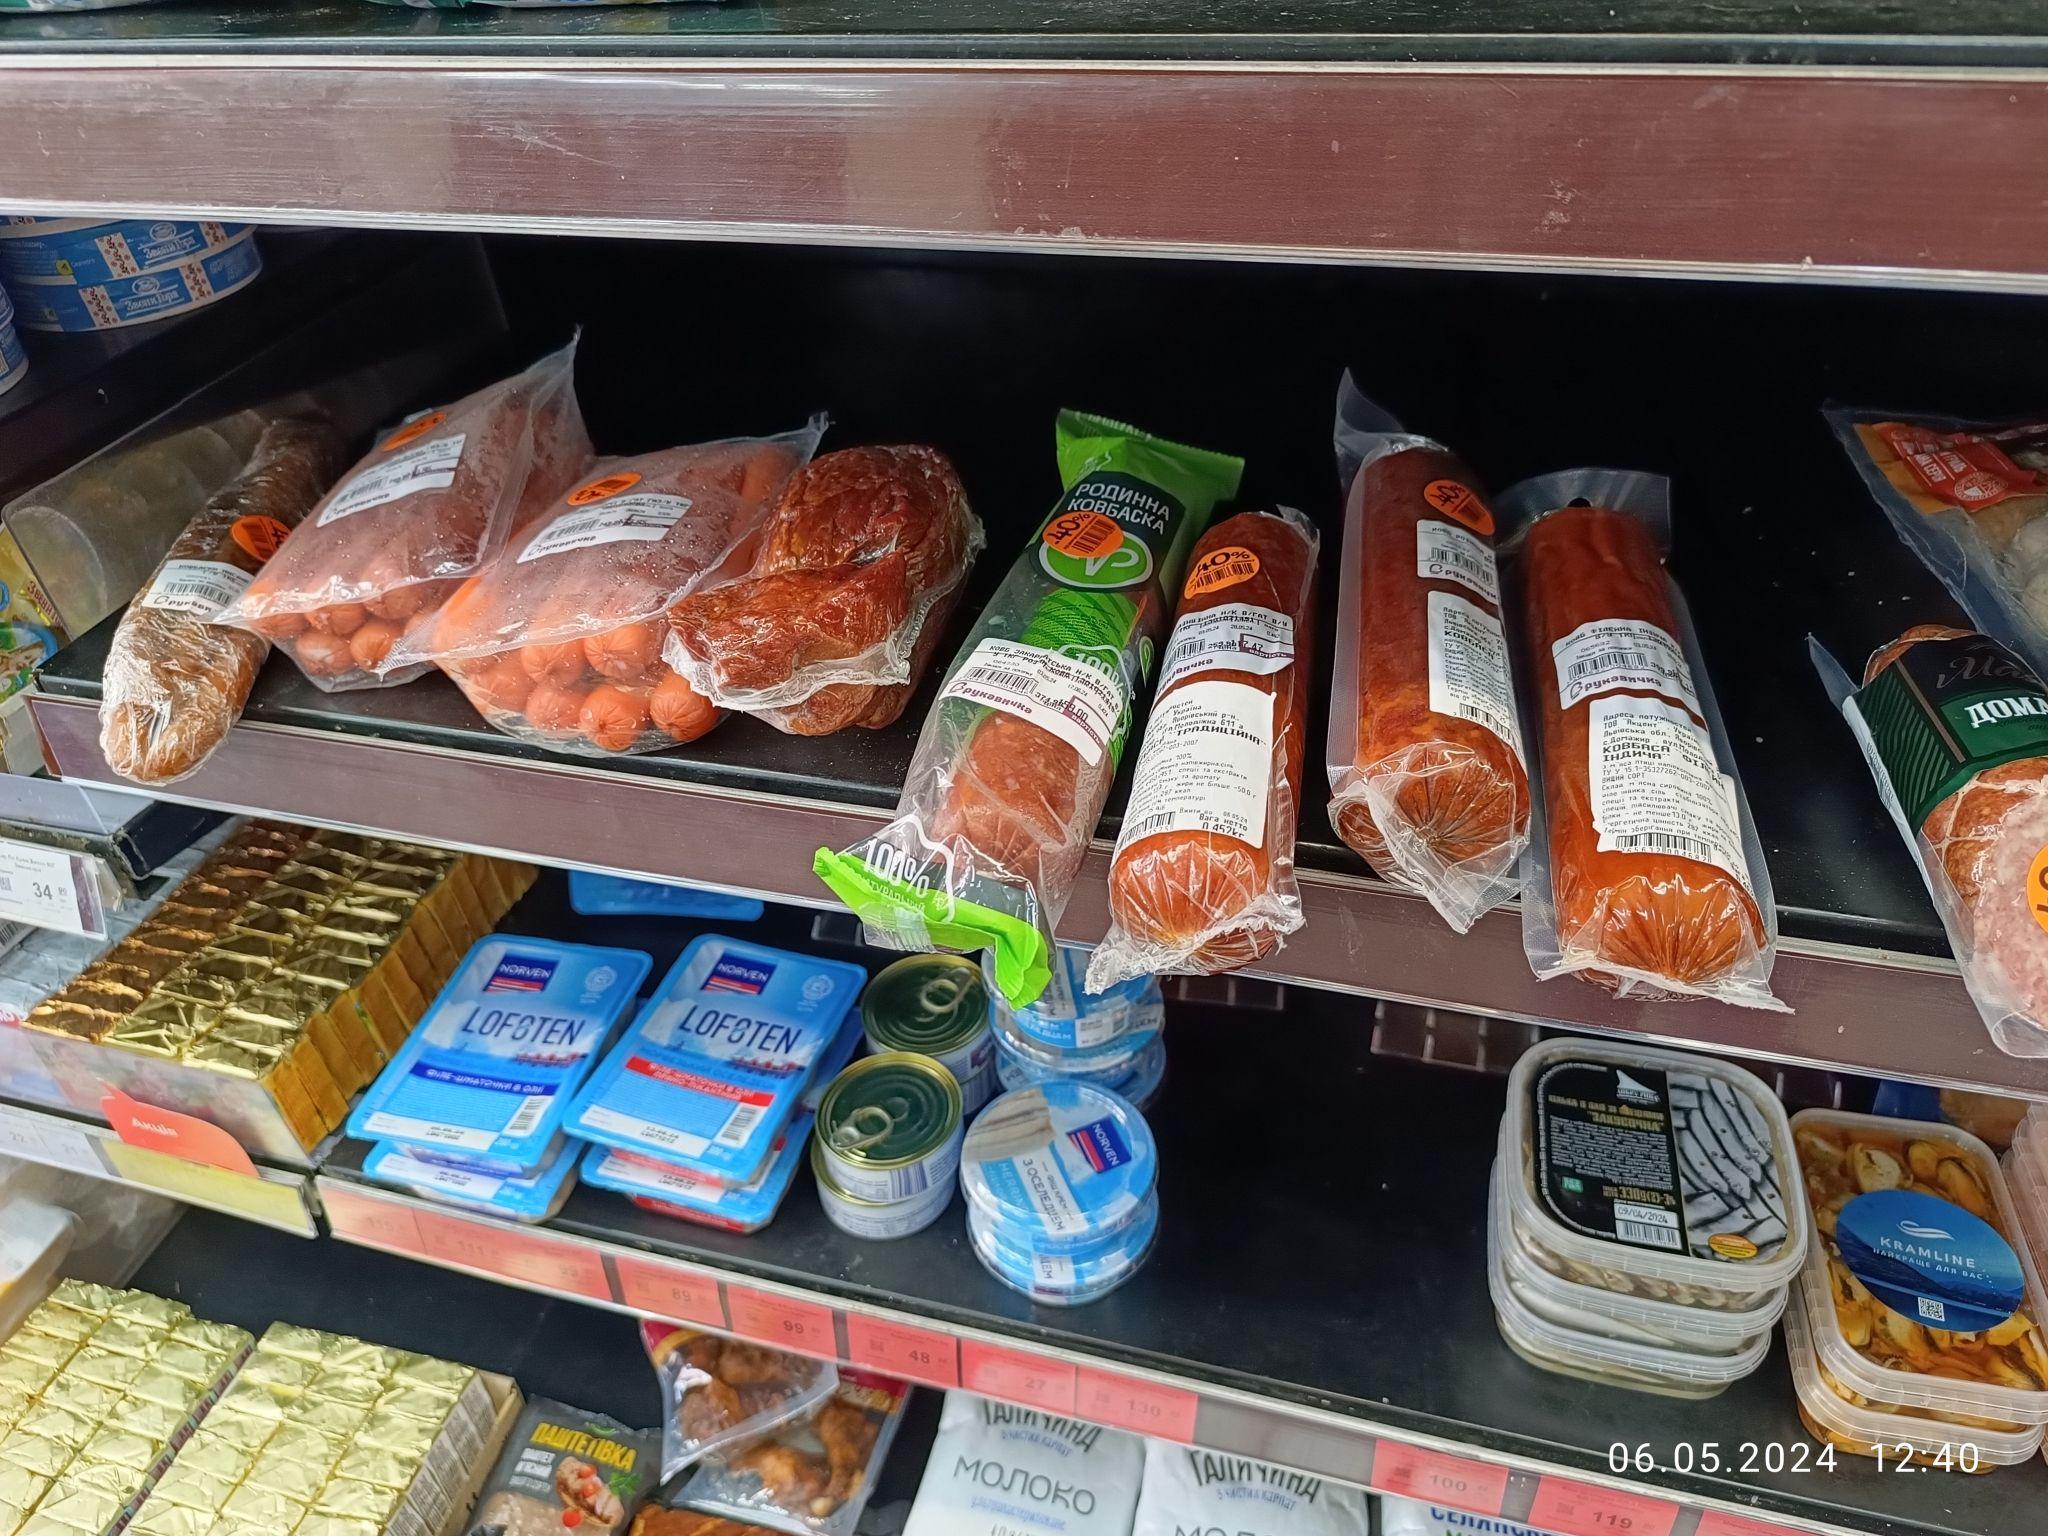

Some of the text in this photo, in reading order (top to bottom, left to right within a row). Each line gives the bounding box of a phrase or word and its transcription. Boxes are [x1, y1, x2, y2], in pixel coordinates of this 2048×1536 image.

[1076, 483, 1171, 521] РОДИННА
[1048, 513, 1091, 546] -40%
[1067, 498, 1165, 536] КОВБАСКА
[1585, 675, 1662, 692] рукавичка
[963, 687, 1033, 715] рукавичка
[1603, 712, 1634, 722] Адреса
[1603, 720, 1618, 729] ТОВ
[1603, 742, 1671, 754] КОВБАСА
[1199, 813, 1248, 832] Вага нетто
[864, 837, 930, 898] 100%
[32, 882, 53, 900] 34
[500, 963, 552, 981] NORVEN
[717, 961, 769, 984] NORVEN
[1093, 1123, 1120, 1167] NORVEN
[1023, 1158, 1033, 1167] З
[1027, 1167, 1065, 1231] ОСЕЛЕДЦЕМ
[1873, 1247, 1983, 1280] НАЙКРАЩЕ ДЛЯ ВАС
[1880, 1236, 1976, 1268] KRAMLINE
[783, 1320, 804, 1334] 99
[908, 1349, 931, 1364] 48
[530, 1422, 638, 1473] ПАШТЕТІВКА
[953, 1454, 1096, 1516] МОЛОКО
[1190, 1450, 1321, 1503] ГАЛИЧИНА
[1593, 1511, 1634, 1530] 119
